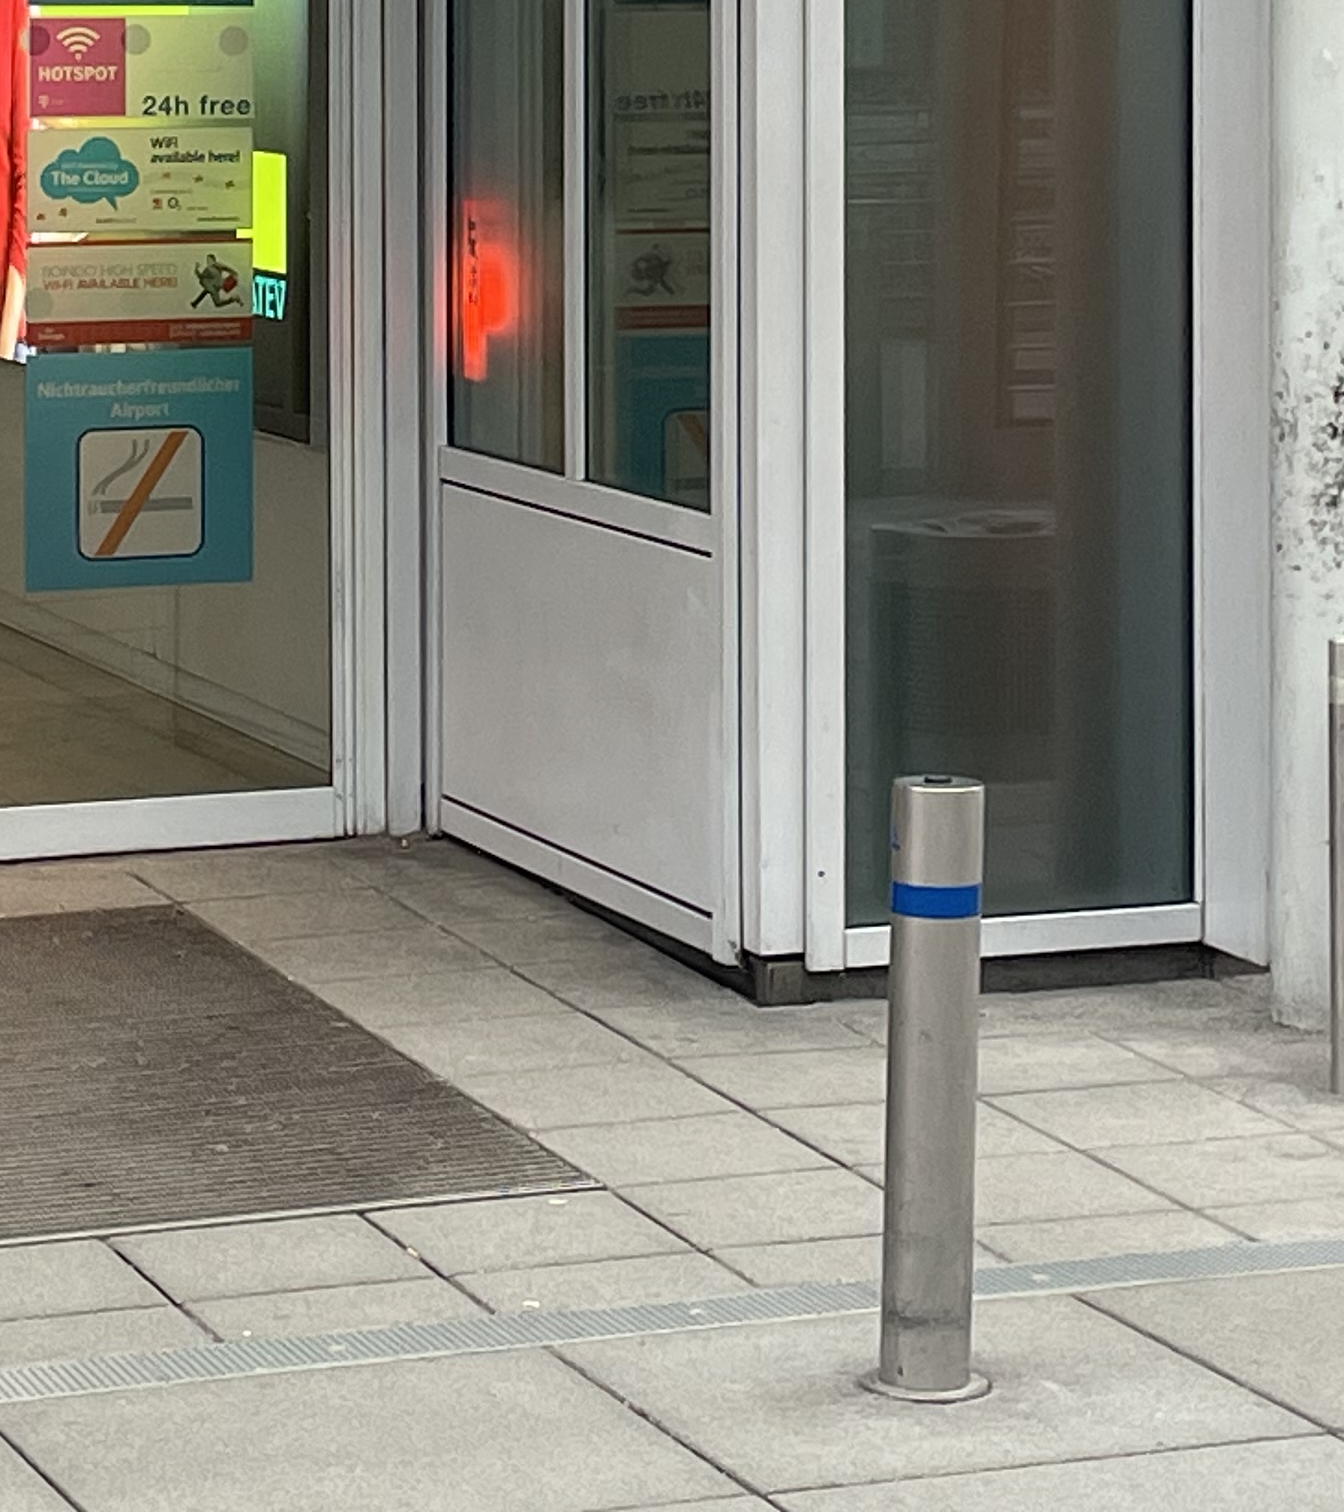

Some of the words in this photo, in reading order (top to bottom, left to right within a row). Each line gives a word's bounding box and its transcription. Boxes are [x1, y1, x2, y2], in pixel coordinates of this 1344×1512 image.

[37, 65, 118, 83] HOTSPOT
[141, 95, 190, 117] 24h
[199, 94, 252, 116] free
[149, 150, 206, 165] available
[50, 170, 81, 186] The
[82, 169, 130, 186] Cloud
[99, 264, 133, 276] HIGH
[136, 263, 178, 276] SPEED
[77, 277, 139, 289] AVAILABLE
[110, 402, 171, 420] Airport
